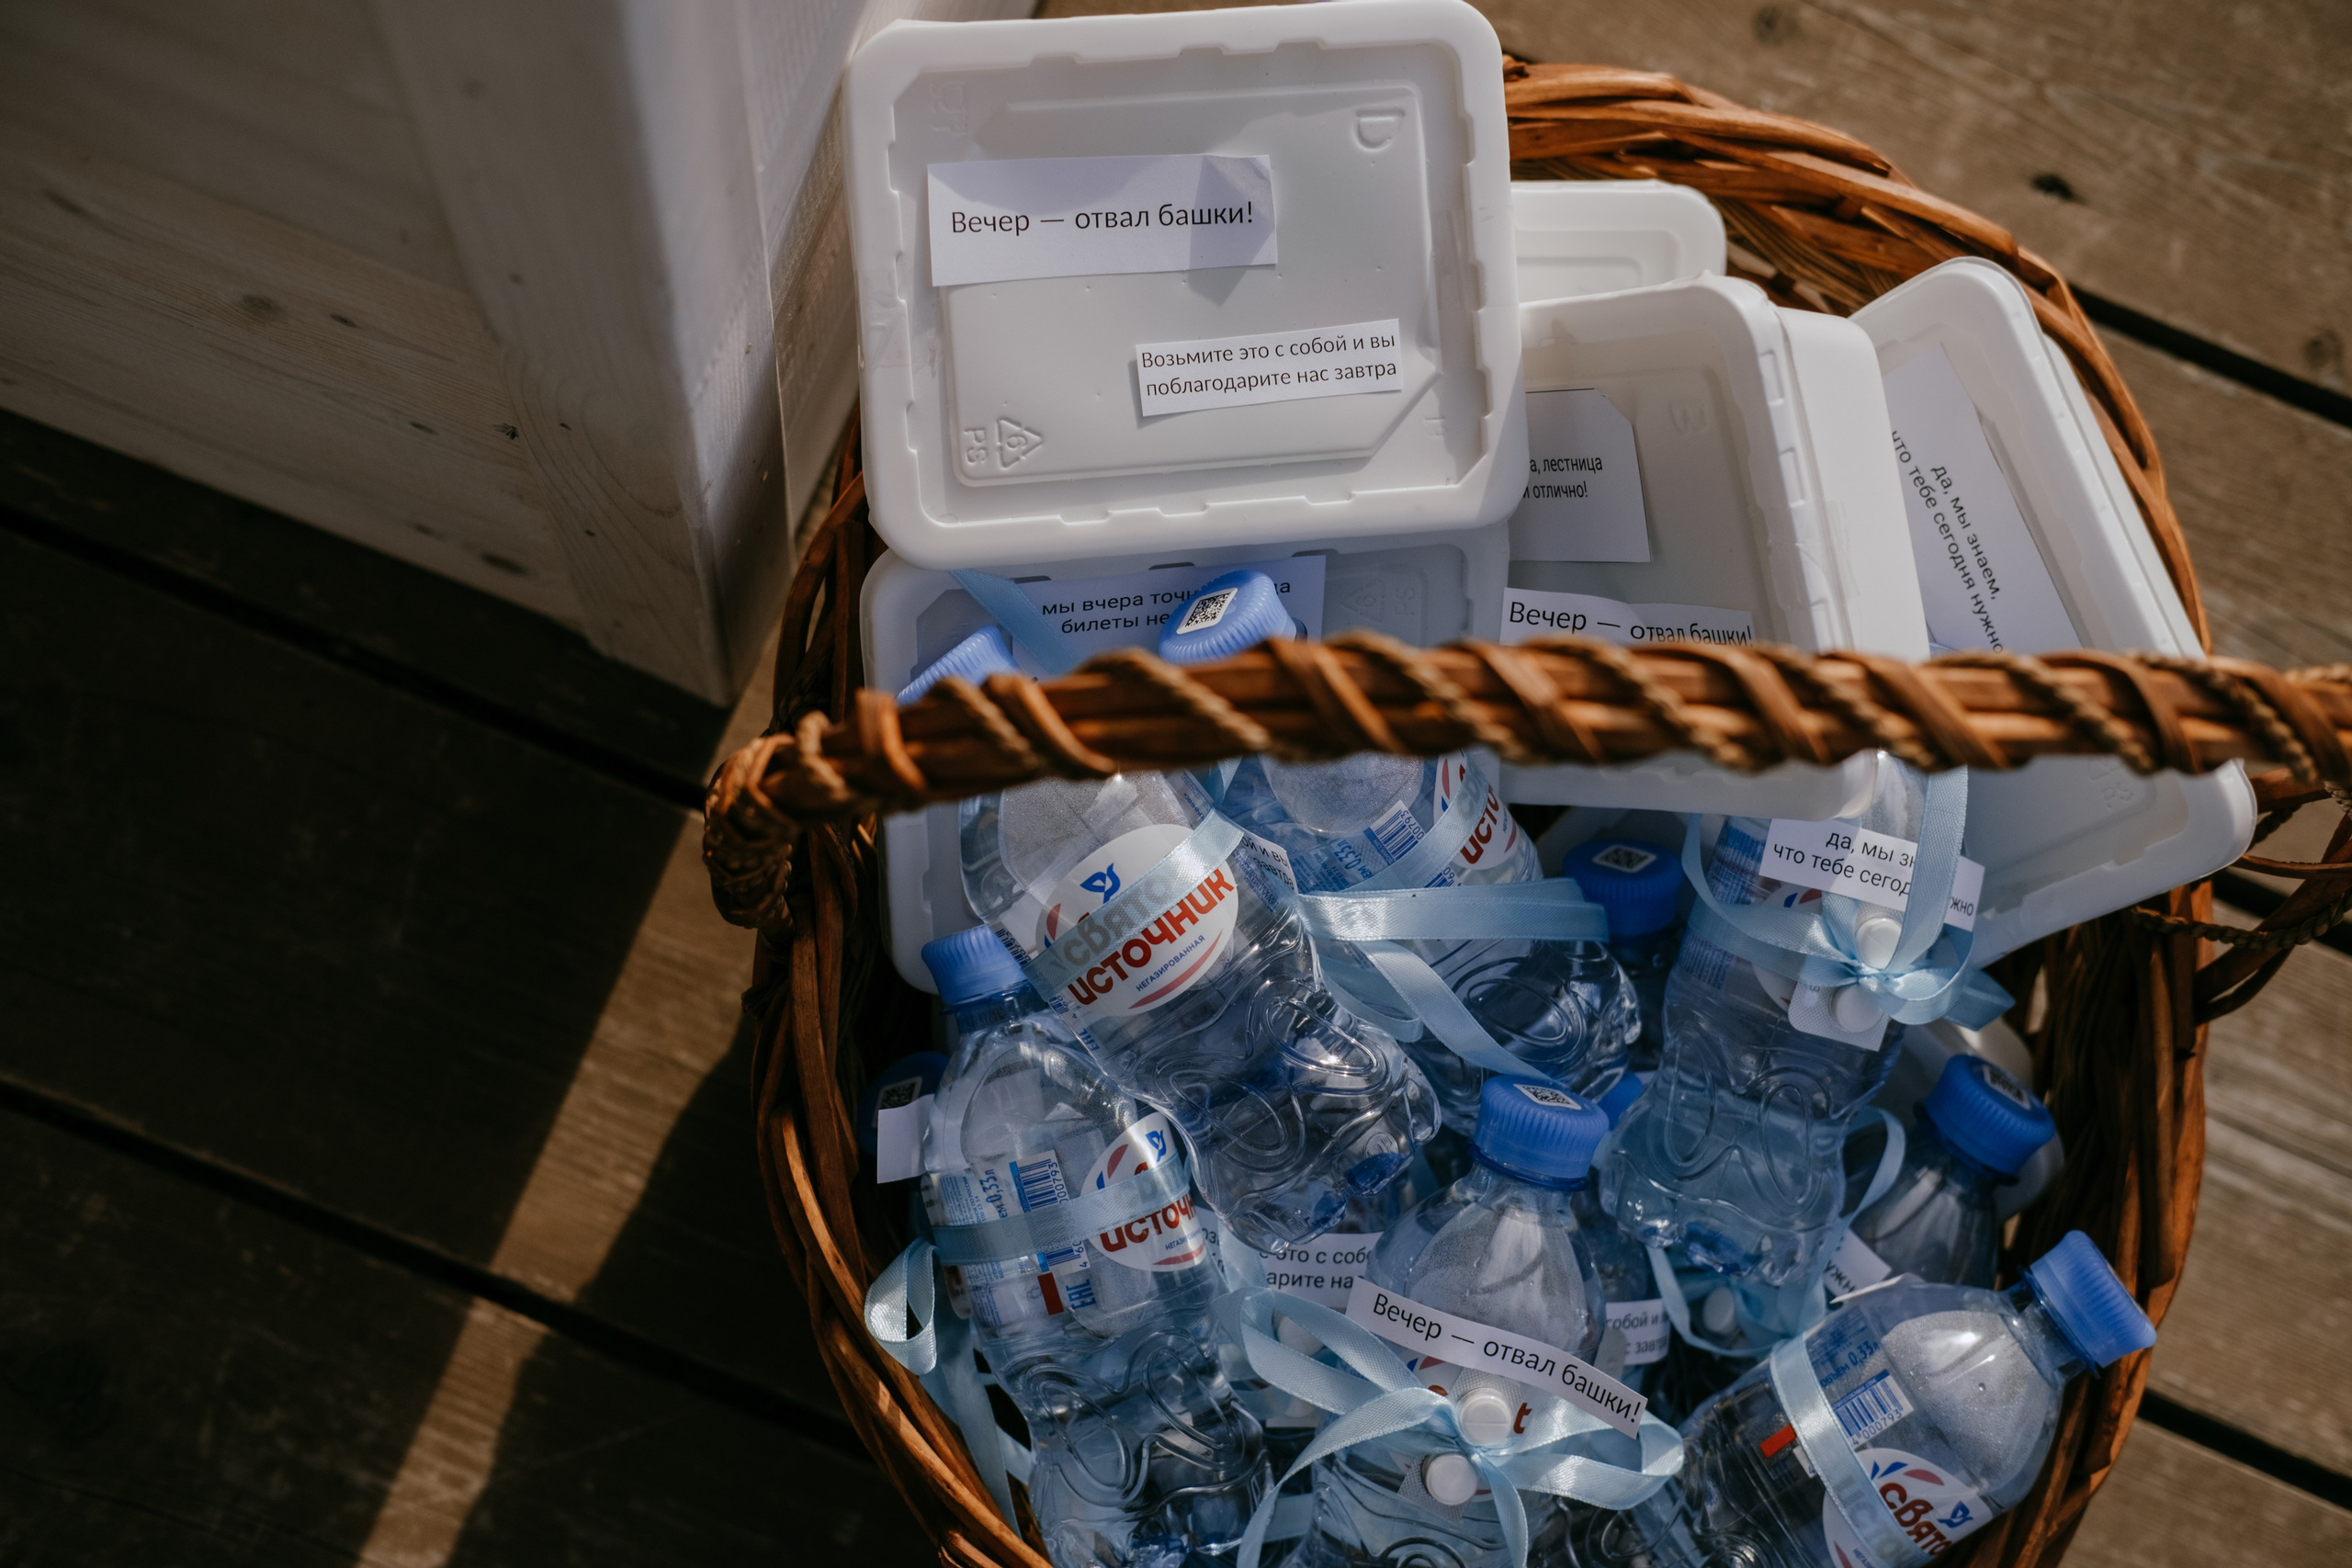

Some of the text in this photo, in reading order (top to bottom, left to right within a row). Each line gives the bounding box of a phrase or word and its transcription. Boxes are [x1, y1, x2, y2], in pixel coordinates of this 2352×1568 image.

[952, 211, 1030, 236] Вечер
[1075, 210, 1149, 230] отвал
[1159, 201, 1253, 227] башки!
[1142, 334, 1396, 367] Возьмите это с собой и вы
[1147, 363, 1396, 396] поблагодарите нас завтра
[1544, 457, 1602, 474] лестница
[1532, 480, 1588, 499] отлично!
[1892, 430, 2004, 654] что тебе сегодня нужно
[1930, 467, 2000, 600] да, мы знаем,
[1042, 601, 1074, 615] мы
[1082, 594, 1144, 612] вчера
[1061, 613, 1138, 634] билеты
[1510, 601, 1587, 635] Вечер
[1630, 625, 1683, 644] отвал
[1690, 623, 1753, 648] башки!
[1460, 784, 1499, 864] ИСТО
[1826, 832, 1855, 853] да,
[1861, 842, 1894, 863] мы
[1774, 844, 1804, 864] что
[1811, 854, 1854, 878] тебе
[1949, 896, 1974, 917] жно
[1136, 934, 1206, 992] НЕГАЗИРОВАННАЯ
[1316, 1250, 1326, 1264] с
[1331, 1274, 1364, 1289] на
[1373, 1292, 1442, 1341] Вечер
[1484, 1340, 1555, 1377] отвал
[1562, 1363, 1642, 1423] башки!
